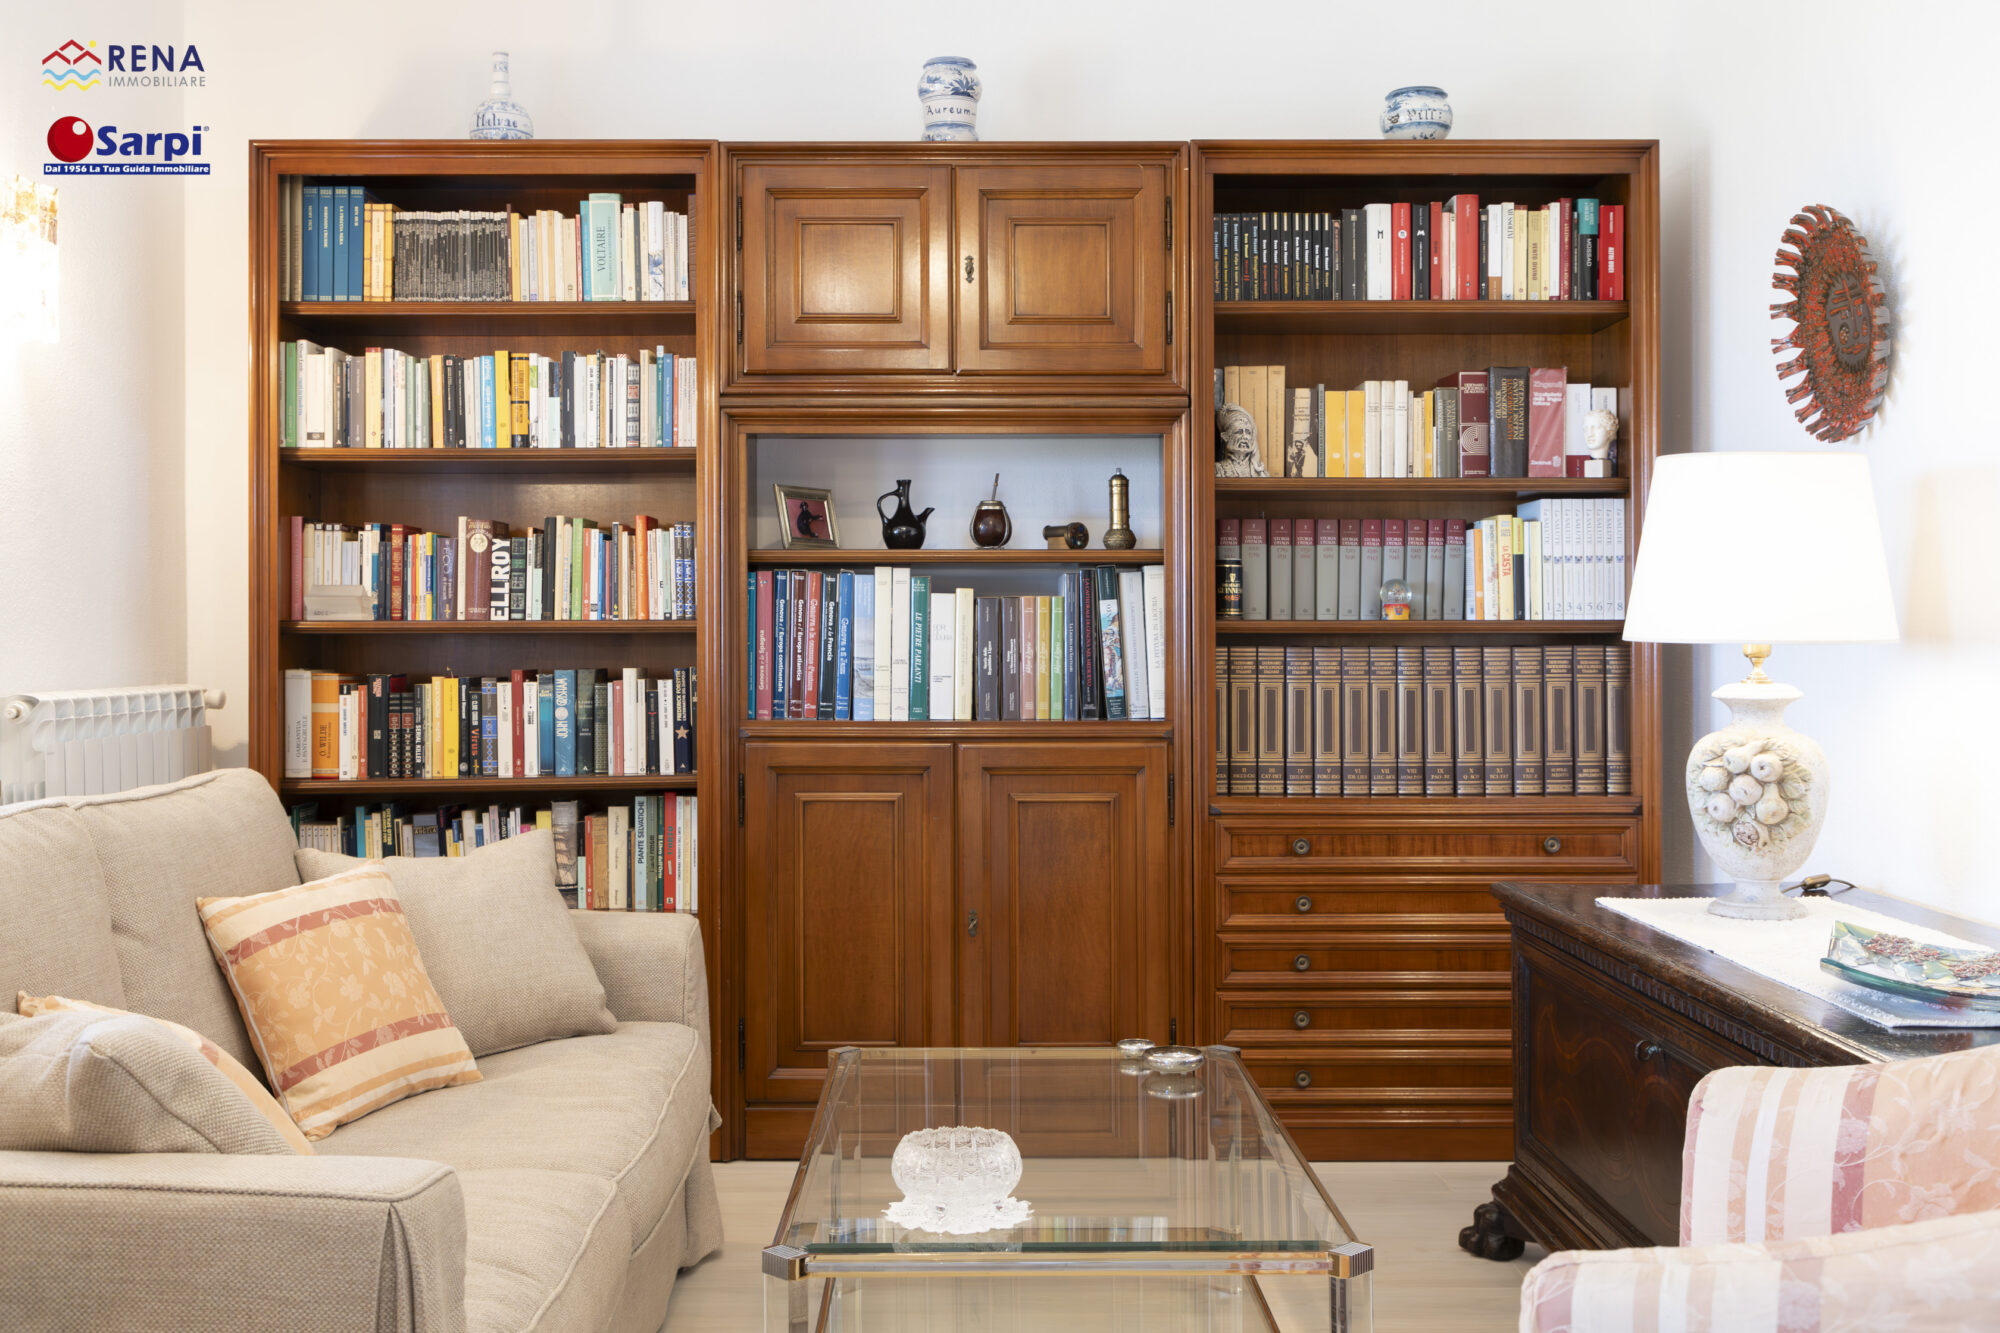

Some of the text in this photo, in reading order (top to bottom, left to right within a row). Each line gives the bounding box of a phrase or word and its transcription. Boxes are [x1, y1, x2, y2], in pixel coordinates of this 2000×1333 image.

[597, 226, 606, 272] VOLTAIRE
[442, 548, 450, 574] ECO
[1502, 553, 1511, 576] CASTA
[491, 538, 510, 620] ELLROY
[810, 599, 818, 626] Genova
[1597, 602, 1602, 611] 6
[1607, 602, 1612, 611] 7
[1617, 602, 1623, 611] 8
[840, 618, 849, 646] Genova
[914, 612, 922, 683] LE PIETRE PARLANTI
[1155, 661, 1160, 669] LA
[556, 678, 569, 739] JOHN GRISHAM
[472, 728, 480, 756] Virus
